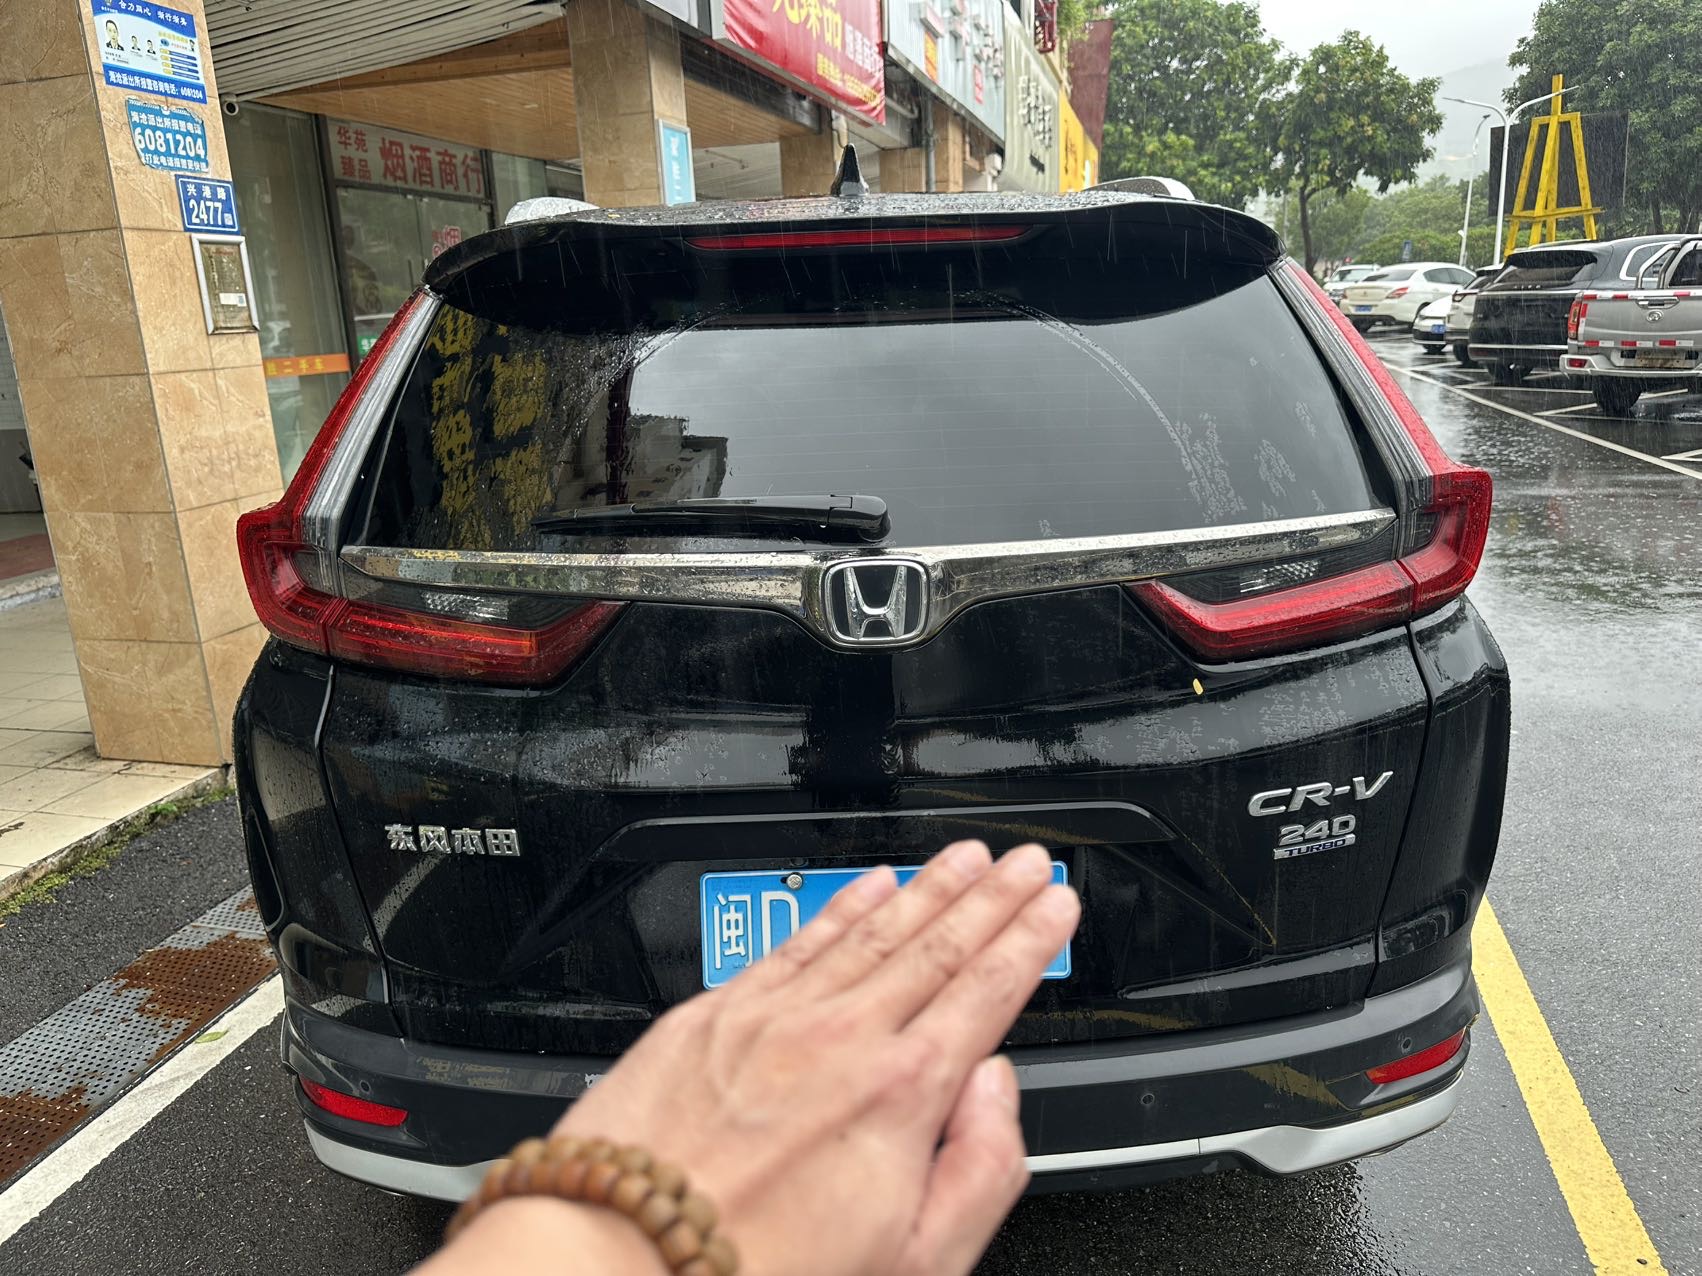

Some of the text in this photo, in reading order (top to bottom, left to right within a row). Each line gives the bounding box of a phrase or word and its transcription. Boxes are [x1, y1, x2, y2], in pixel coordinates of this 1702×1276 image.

[130, 110, 202, 135] 海沧派出所报警电话
[134, 127, 205, 159] 6081204
[337, 126, 482, 194] 华苑 烟酒商行
[187, 184, 226, 200] 兴港路
[189, 199, 223, 225] 2477
[1248, 770, 1394, 817] CR-V
[384, 824, 520, 857] 东风本田
[1279, 814, 1356, 846] 240
[1282, 837, 1349, 858] TURBO
